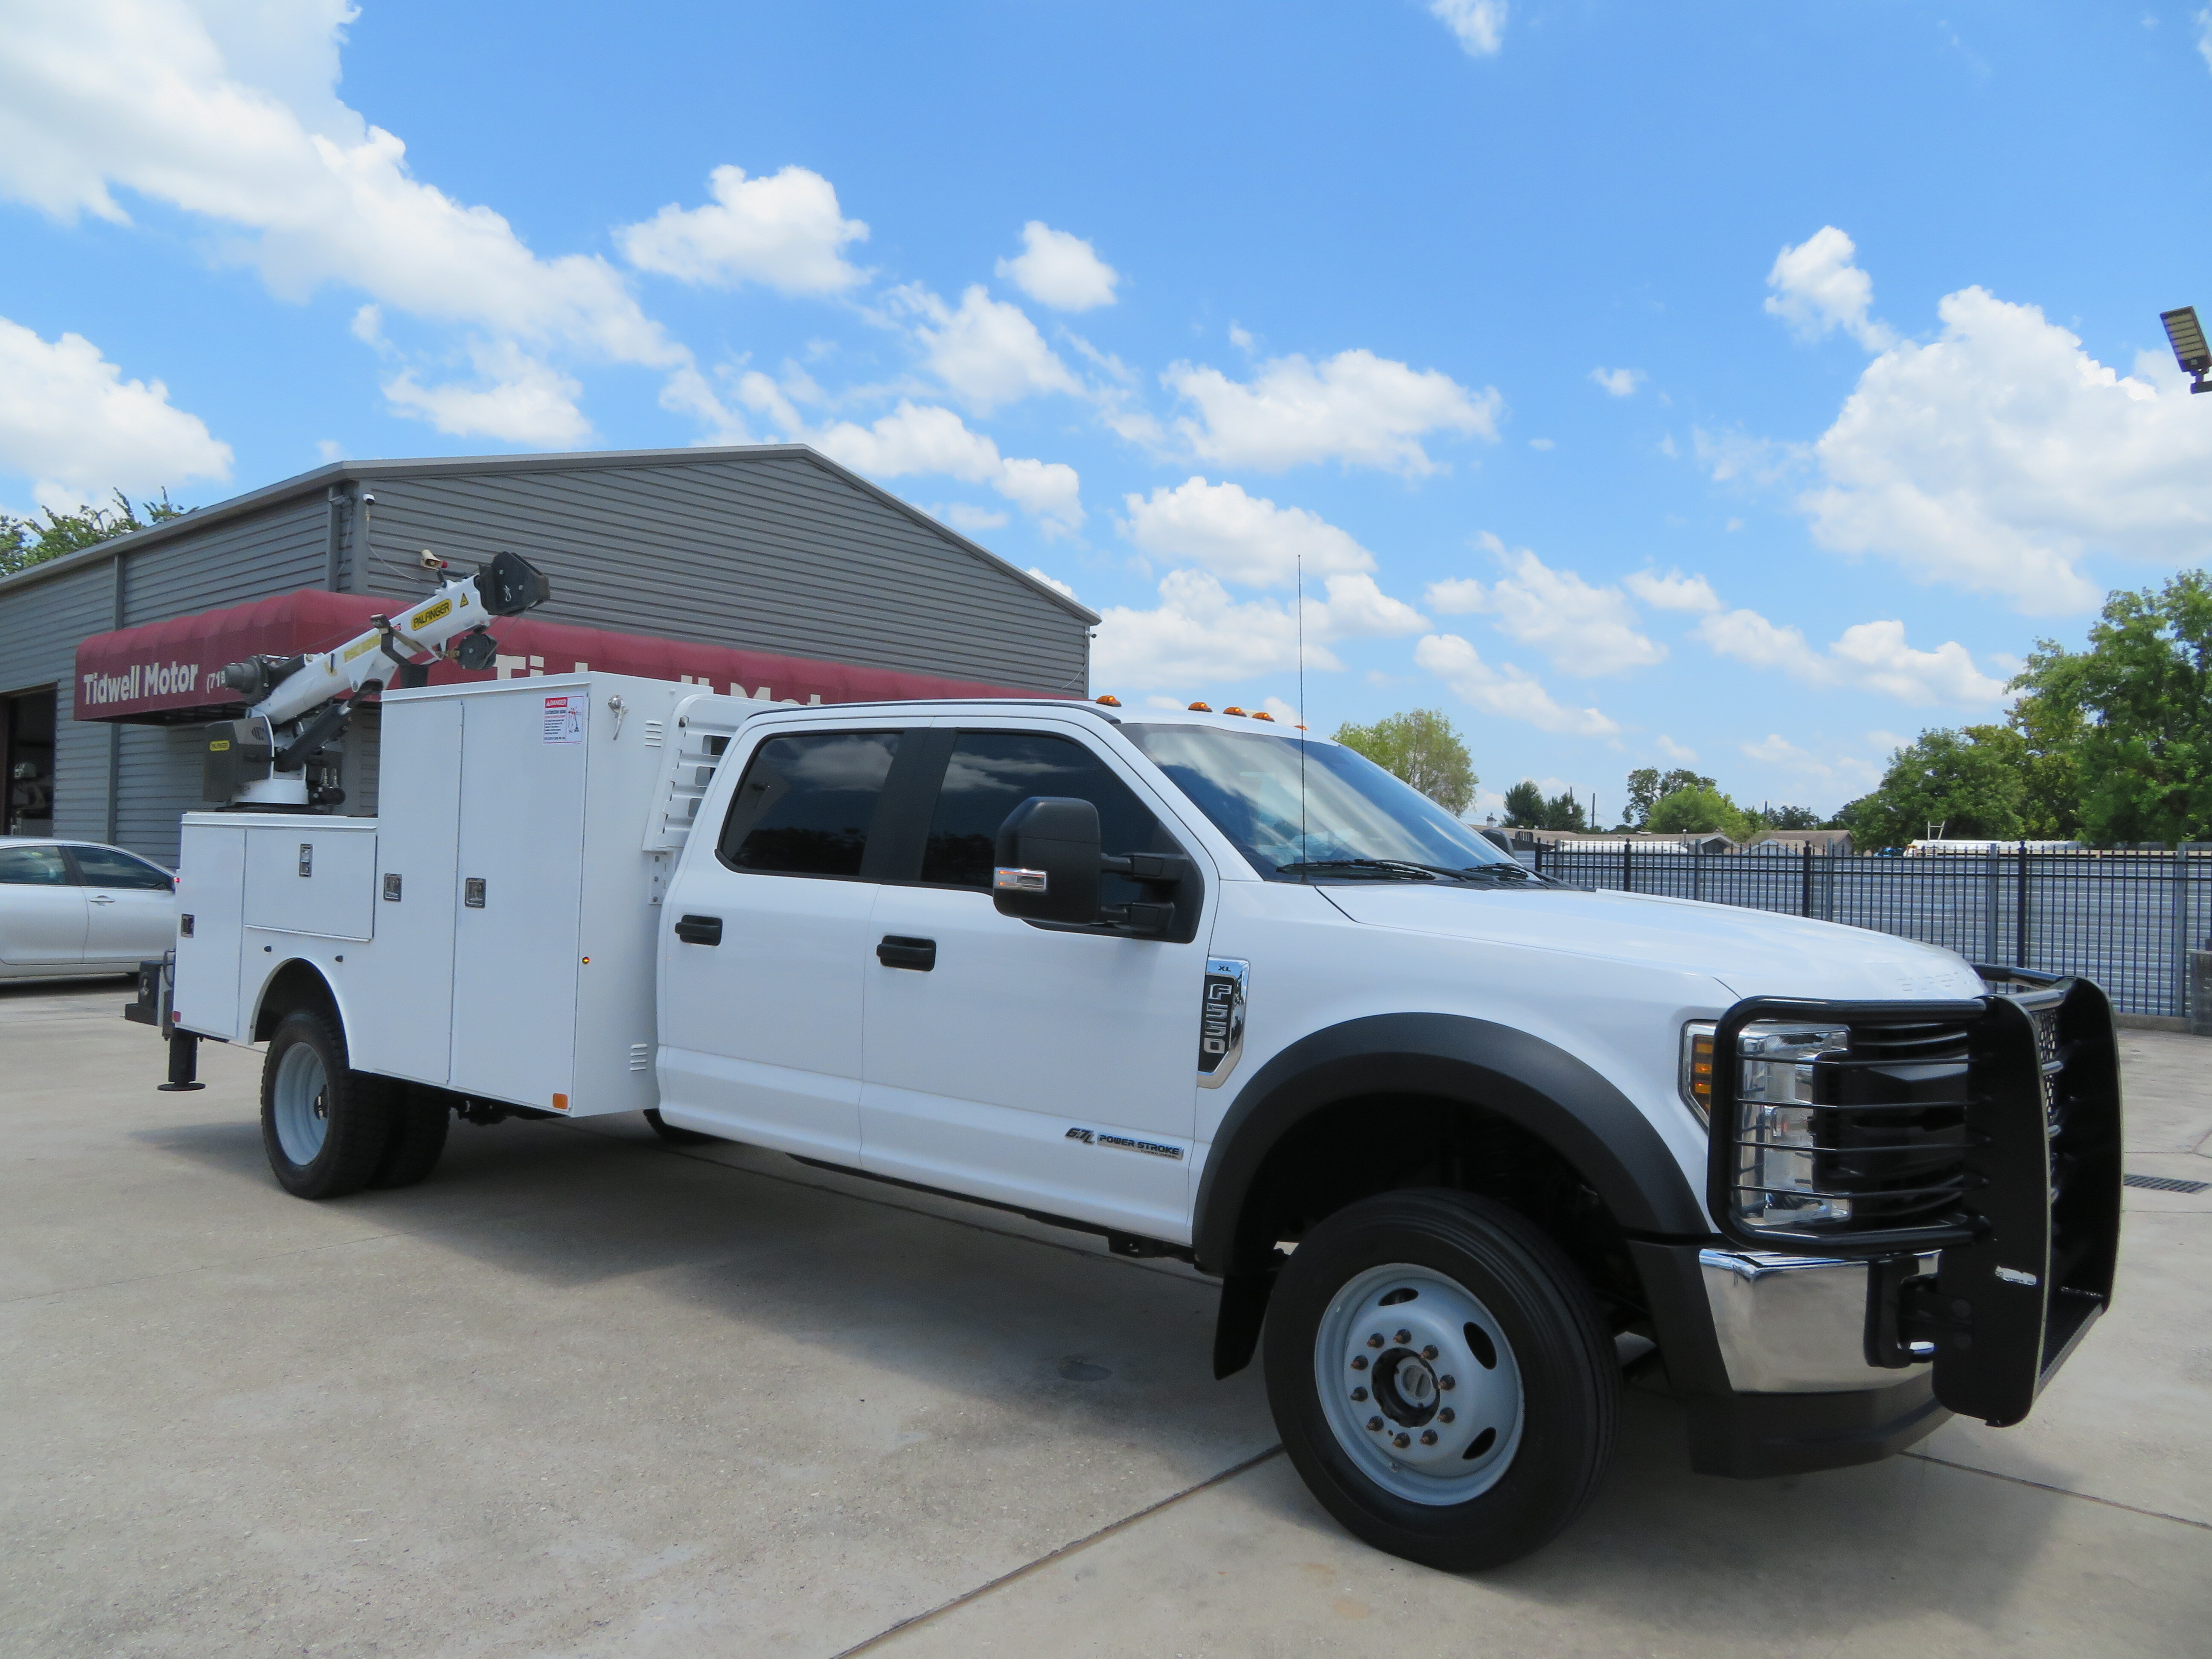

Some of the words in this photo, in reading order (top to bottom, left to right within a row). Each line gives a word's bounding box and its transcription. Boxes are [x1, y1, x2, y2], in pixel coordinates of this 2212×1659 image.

[84, 664, 140, 705] Tidwell
[144, 661, 199, 697] Motor
[1099, 1134, 1135, 1147] POWER
[1137, 1141, 1180, 1155] STROKE
